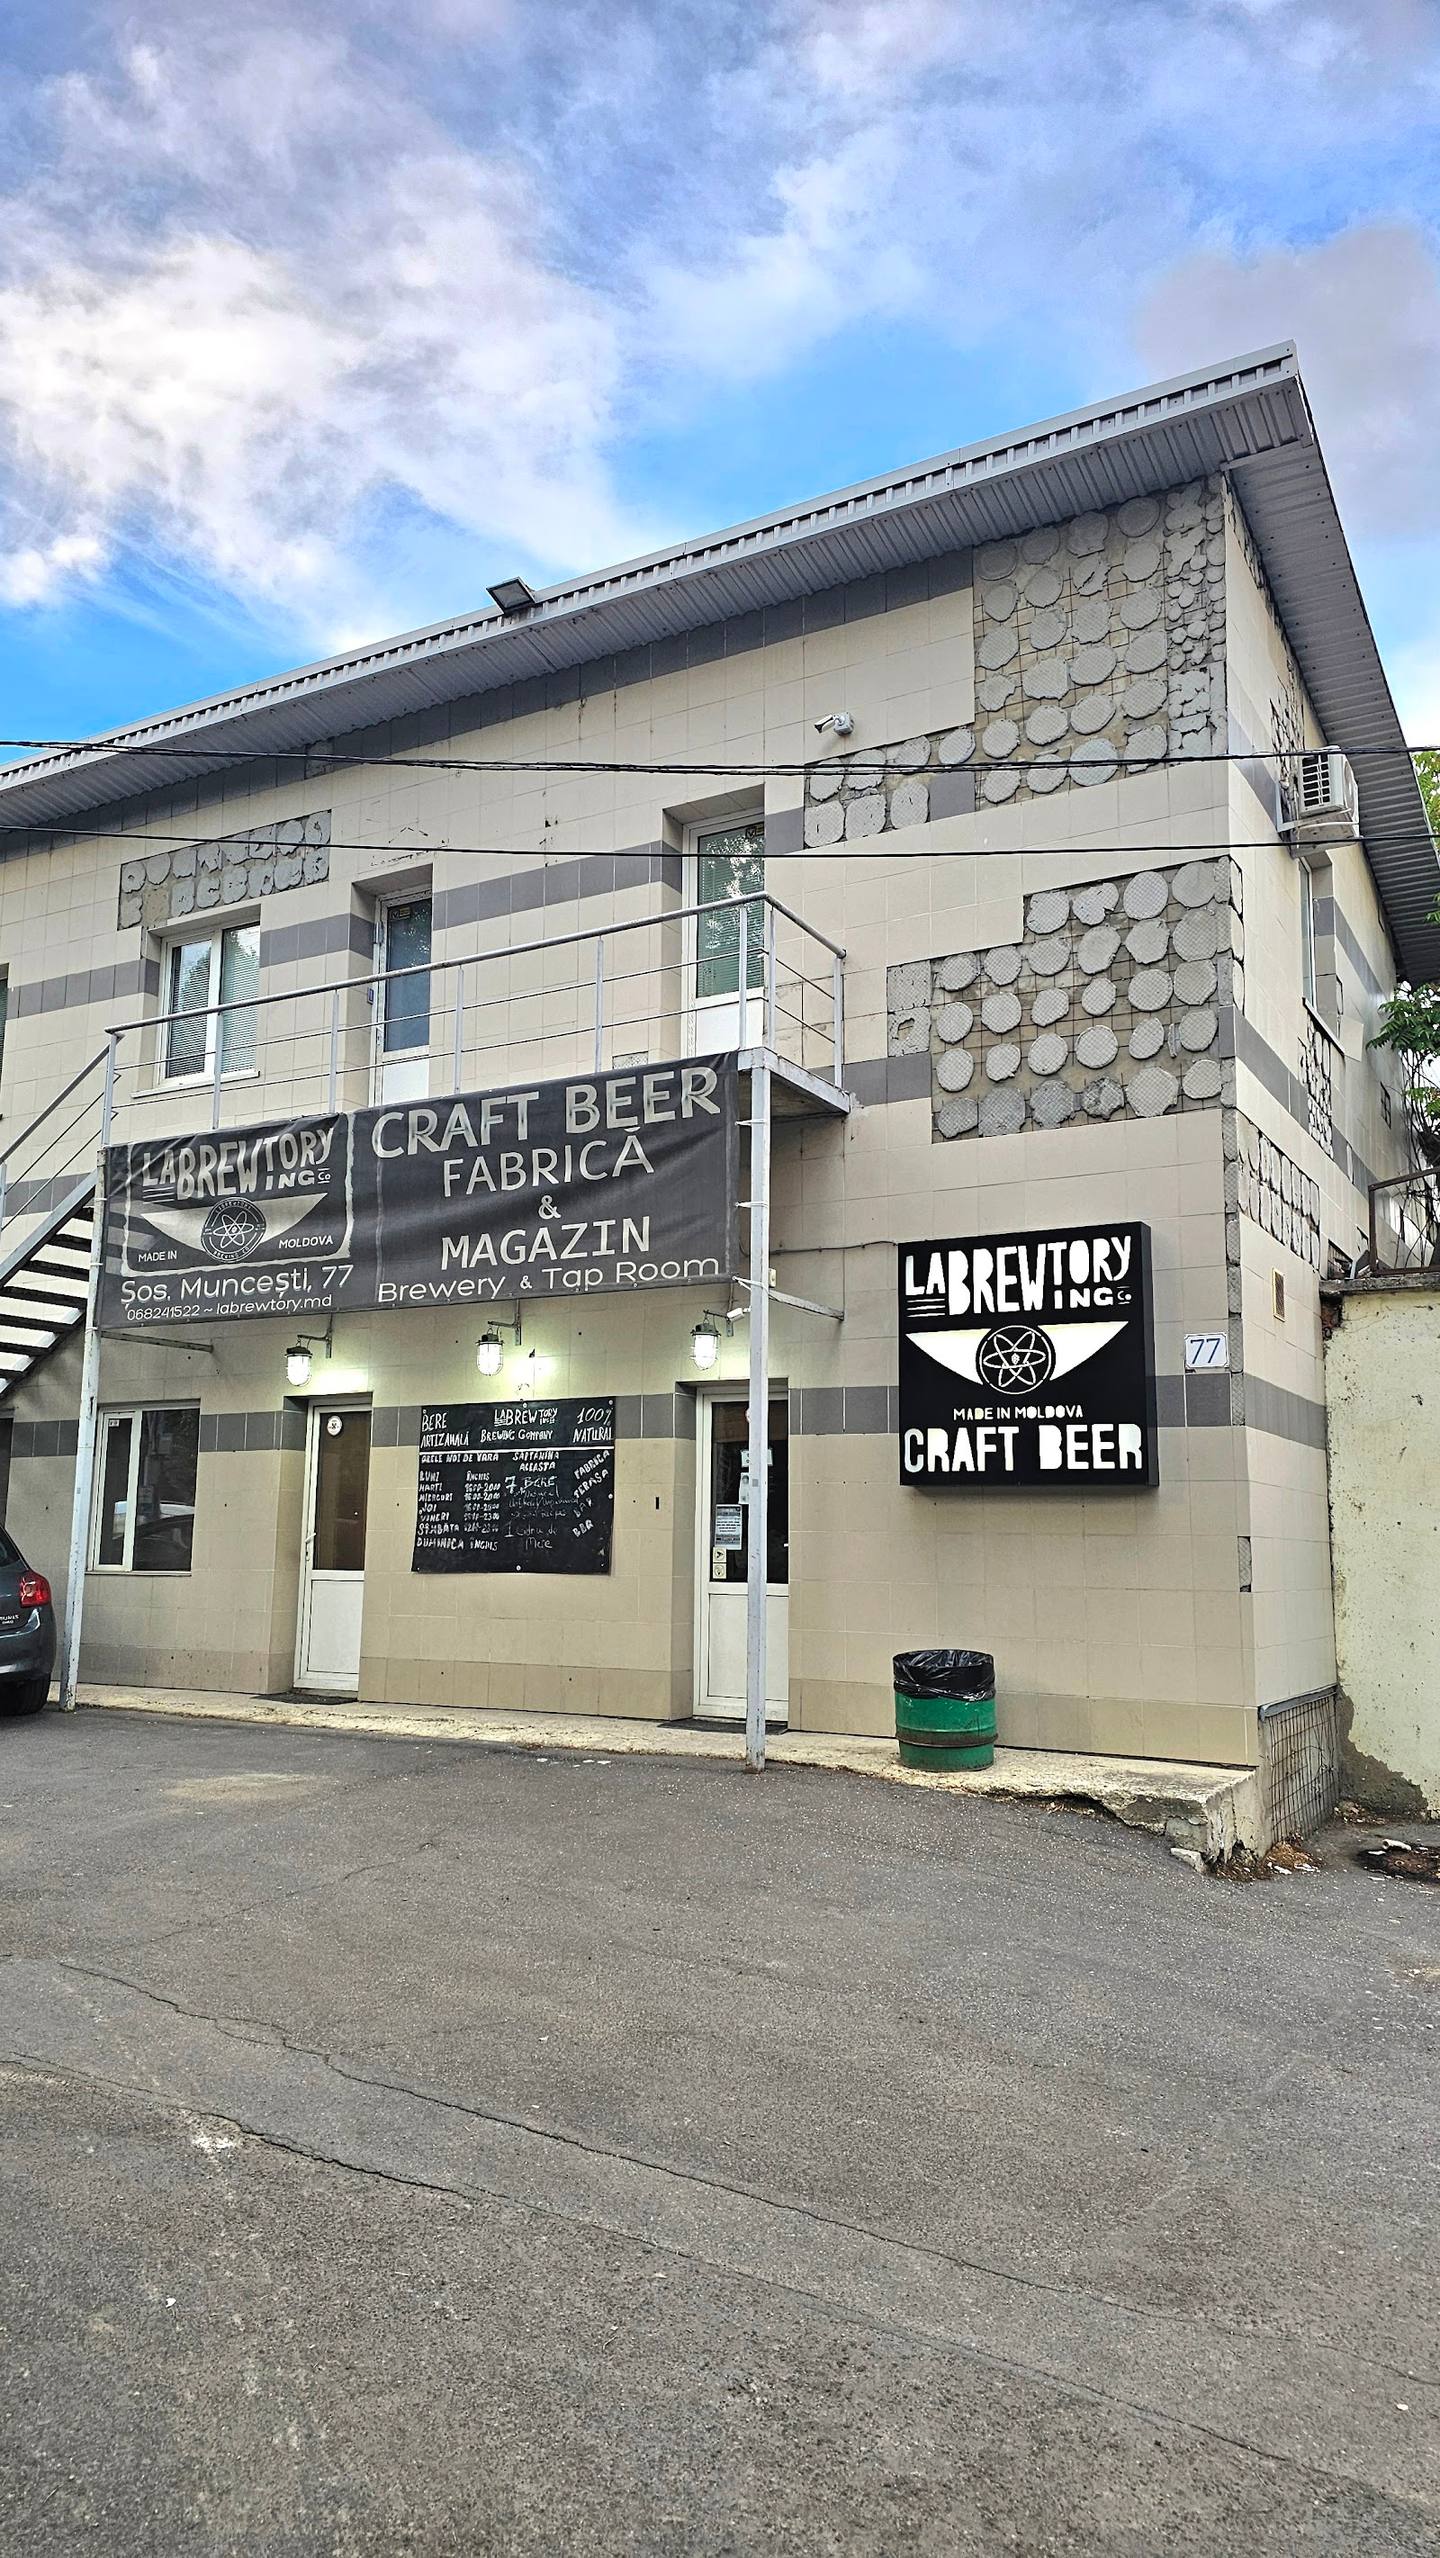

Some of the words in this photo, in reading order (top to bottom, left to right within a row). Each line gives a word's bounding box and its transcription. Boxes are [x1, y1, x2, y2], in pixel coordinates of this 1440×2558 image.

[371, 1092, 539, 1158] CRAFT
[566, 1066, 720, 1134] BEER
[443, 1126, 655, 1197] FABRICĂ
[538, 1195, 561, 1219] &
[278, 1234, 333, 1249] MOLDOVA
[440, 1215, 650, 1270] MAGAZIN
[138, 1252, 161, 1263] MADE
[164, 1250, 178, 1261] IN
[321, 1264, 354, 1290] 77
[377, 1275, 506, 1303] Brewery
[519, 1275, 533, 1290] &
[541, 1265, 604, 1292] Tap
[616, 1257, 720, 1283] Room
[905, 1235, 1132, 1316] LABREWTORY
[127, 1304, 200, 1321] 068241522
[216, 1293, 332, 1315] labrewtory.md
[1189, 1337, 1222, 1365] 77
[421, 1412, 447, 1432] BERE
[577, 1407, 613, 1426] 100%
[953, 1407, 994, 1421] MADE
[996, 1406, 1011, 1419] IN
[1015, 1404, 1084, 1419] MOLDOVA
[573, 1427, 612, 1443] NATURAL
[462, 1453, 473, 1462] DE
[904, 1426, 1020, 1473] CRAFT
[1039, 1423, 1143, 1470] BEER
[504, 1475, 518, 1494] 7
[421, 1502, 437, 1512] JOI
